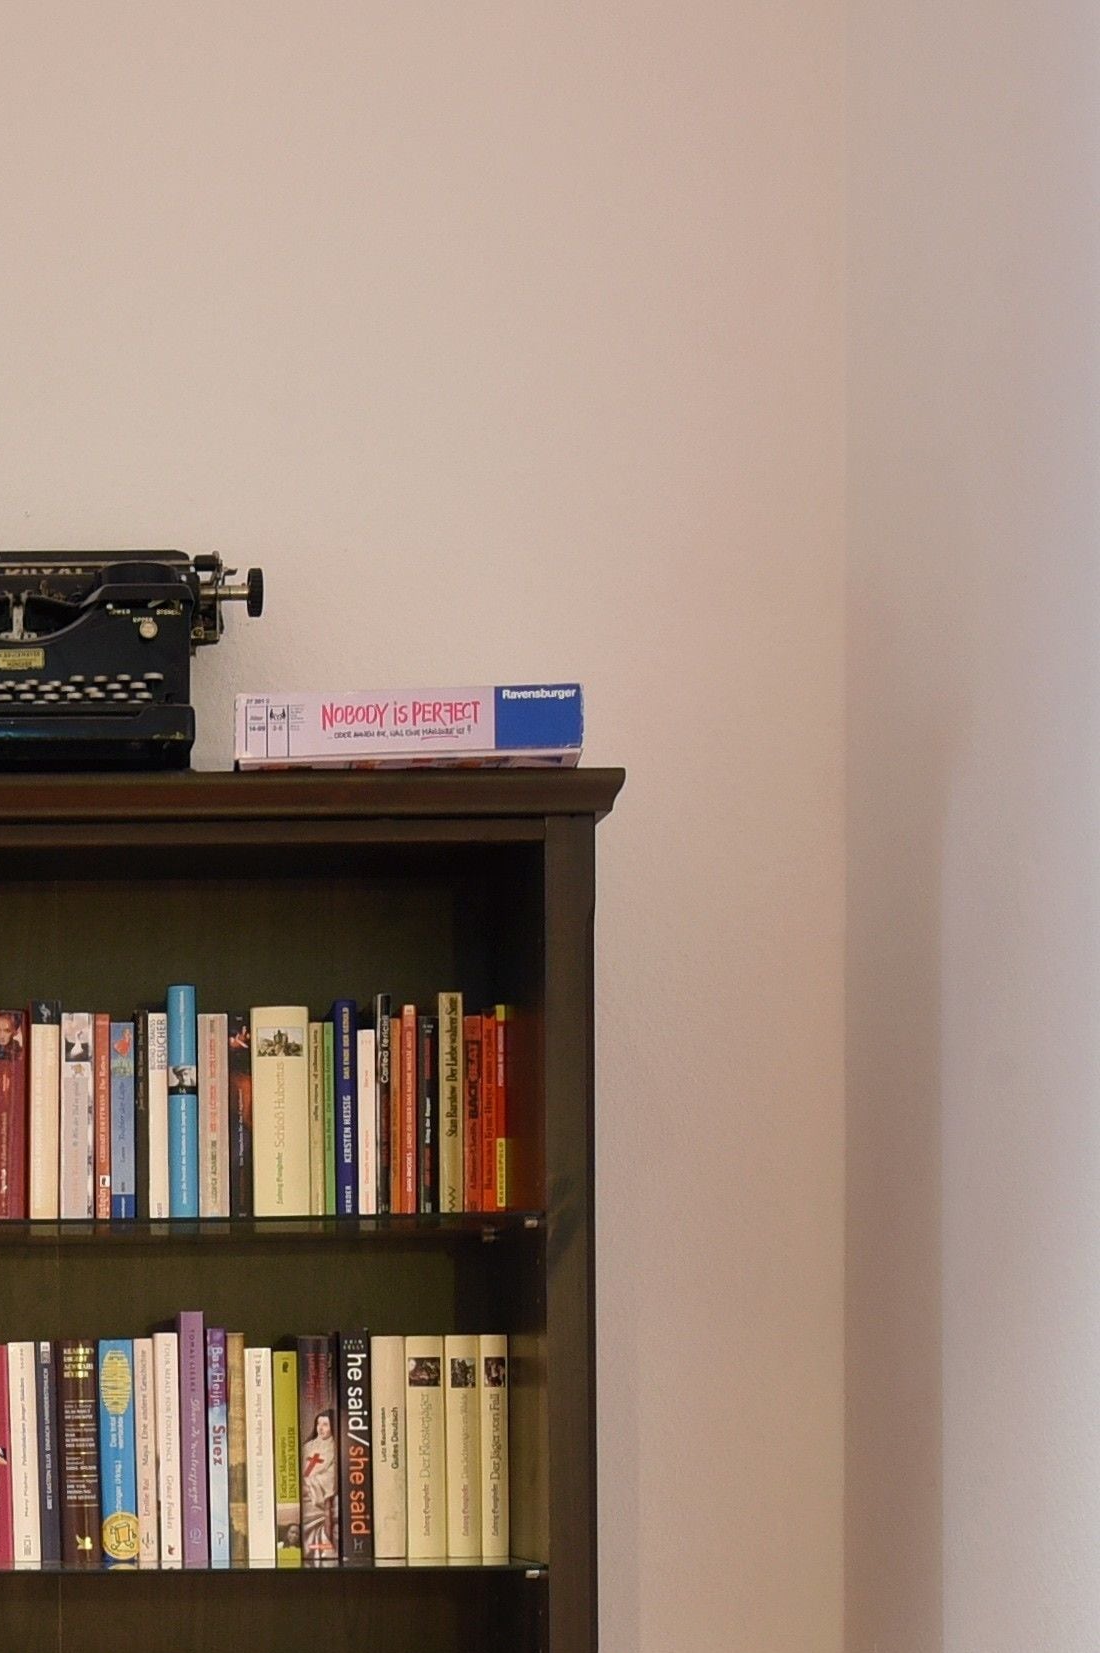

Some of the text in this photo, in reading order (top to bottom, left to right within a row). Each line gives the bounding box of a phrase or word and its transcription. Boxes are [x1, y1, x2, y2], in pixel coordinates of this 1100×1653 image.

[321, 700, 481, 731] NOBODY PERFECT
[502, 687, 577, 700] Ravensburger
[156, 1018, 166, 1070] BESUCHER
[380, 1050, 390, 1084] Cartea
[274, 1062, 286, 1148] Schloß Hubertus
[446, 1046, 458, 1138] Stan Barstow Der Liebe
[342, 1034, 354, 1212] HERDER KIRSTEN HEISIG DAS ENDE DER
[140, 1394, 148, 1420] andere
[210, 1346, 224, 1466] Bas Suez
[346, 1352, 370, 1536] he said
[390, 1406, 400, 1470] Gutes Deutsch
[418, 1392, 432, 1480] Der Klosterjäger
[286, 1454, 296, 1484] LEBEN
[490, 1462, 500, 1480] Der
